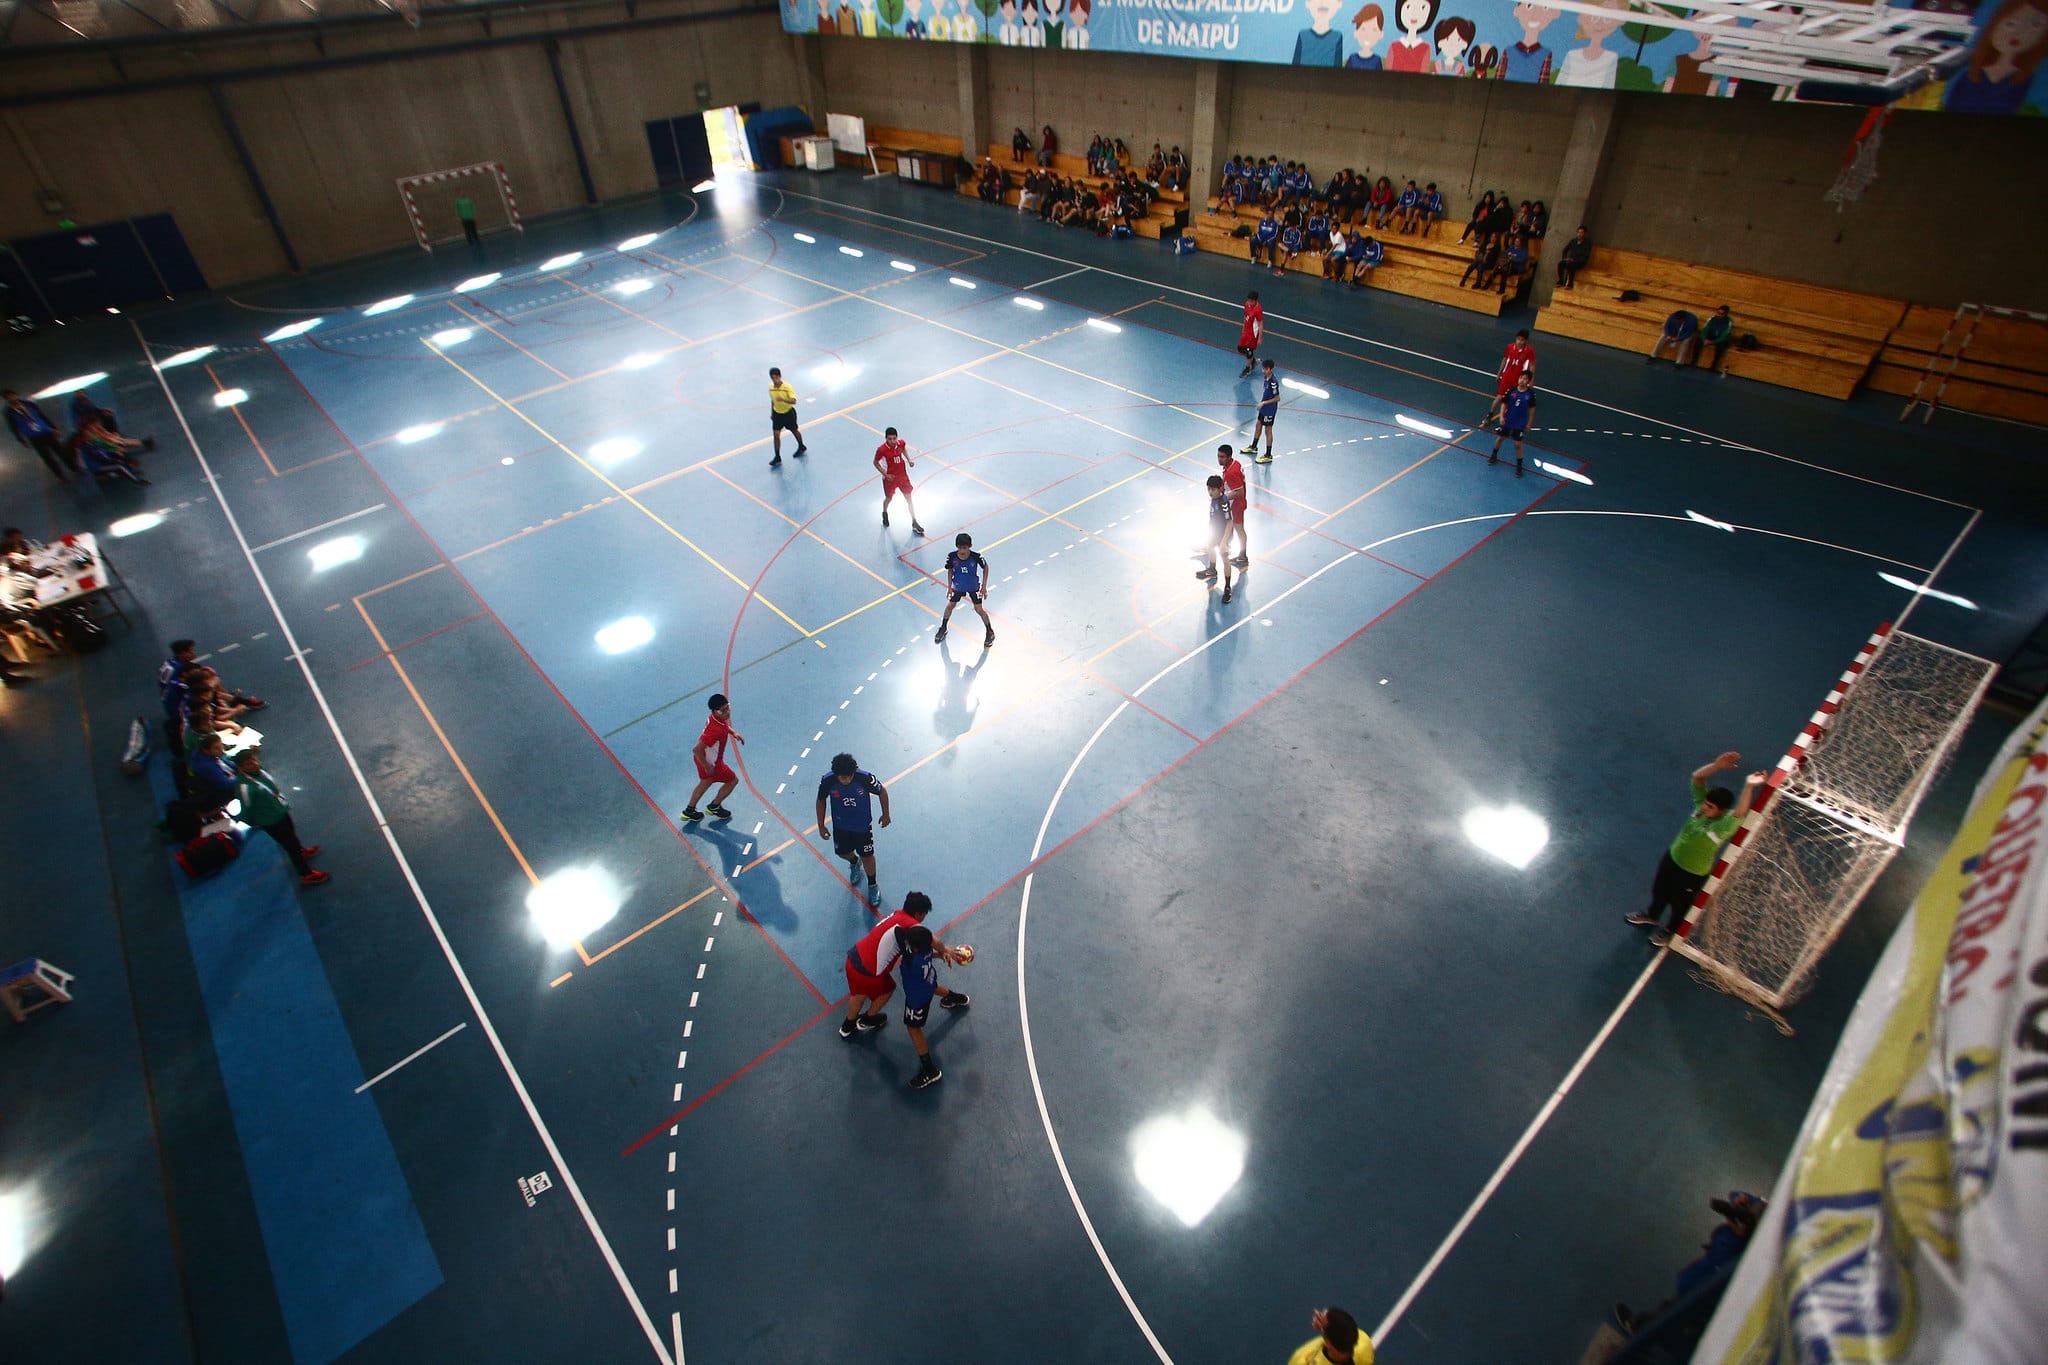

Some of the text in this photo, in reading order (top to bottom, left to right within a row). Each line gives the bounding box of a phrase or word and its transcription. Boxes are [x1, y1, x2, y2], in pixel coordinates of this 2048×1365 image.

[1138, 15, 1239, 50] DE MAIPÚ
[843, 797, 857, 807] 25
[1946, 750, 2048, 1001] QUETBO
